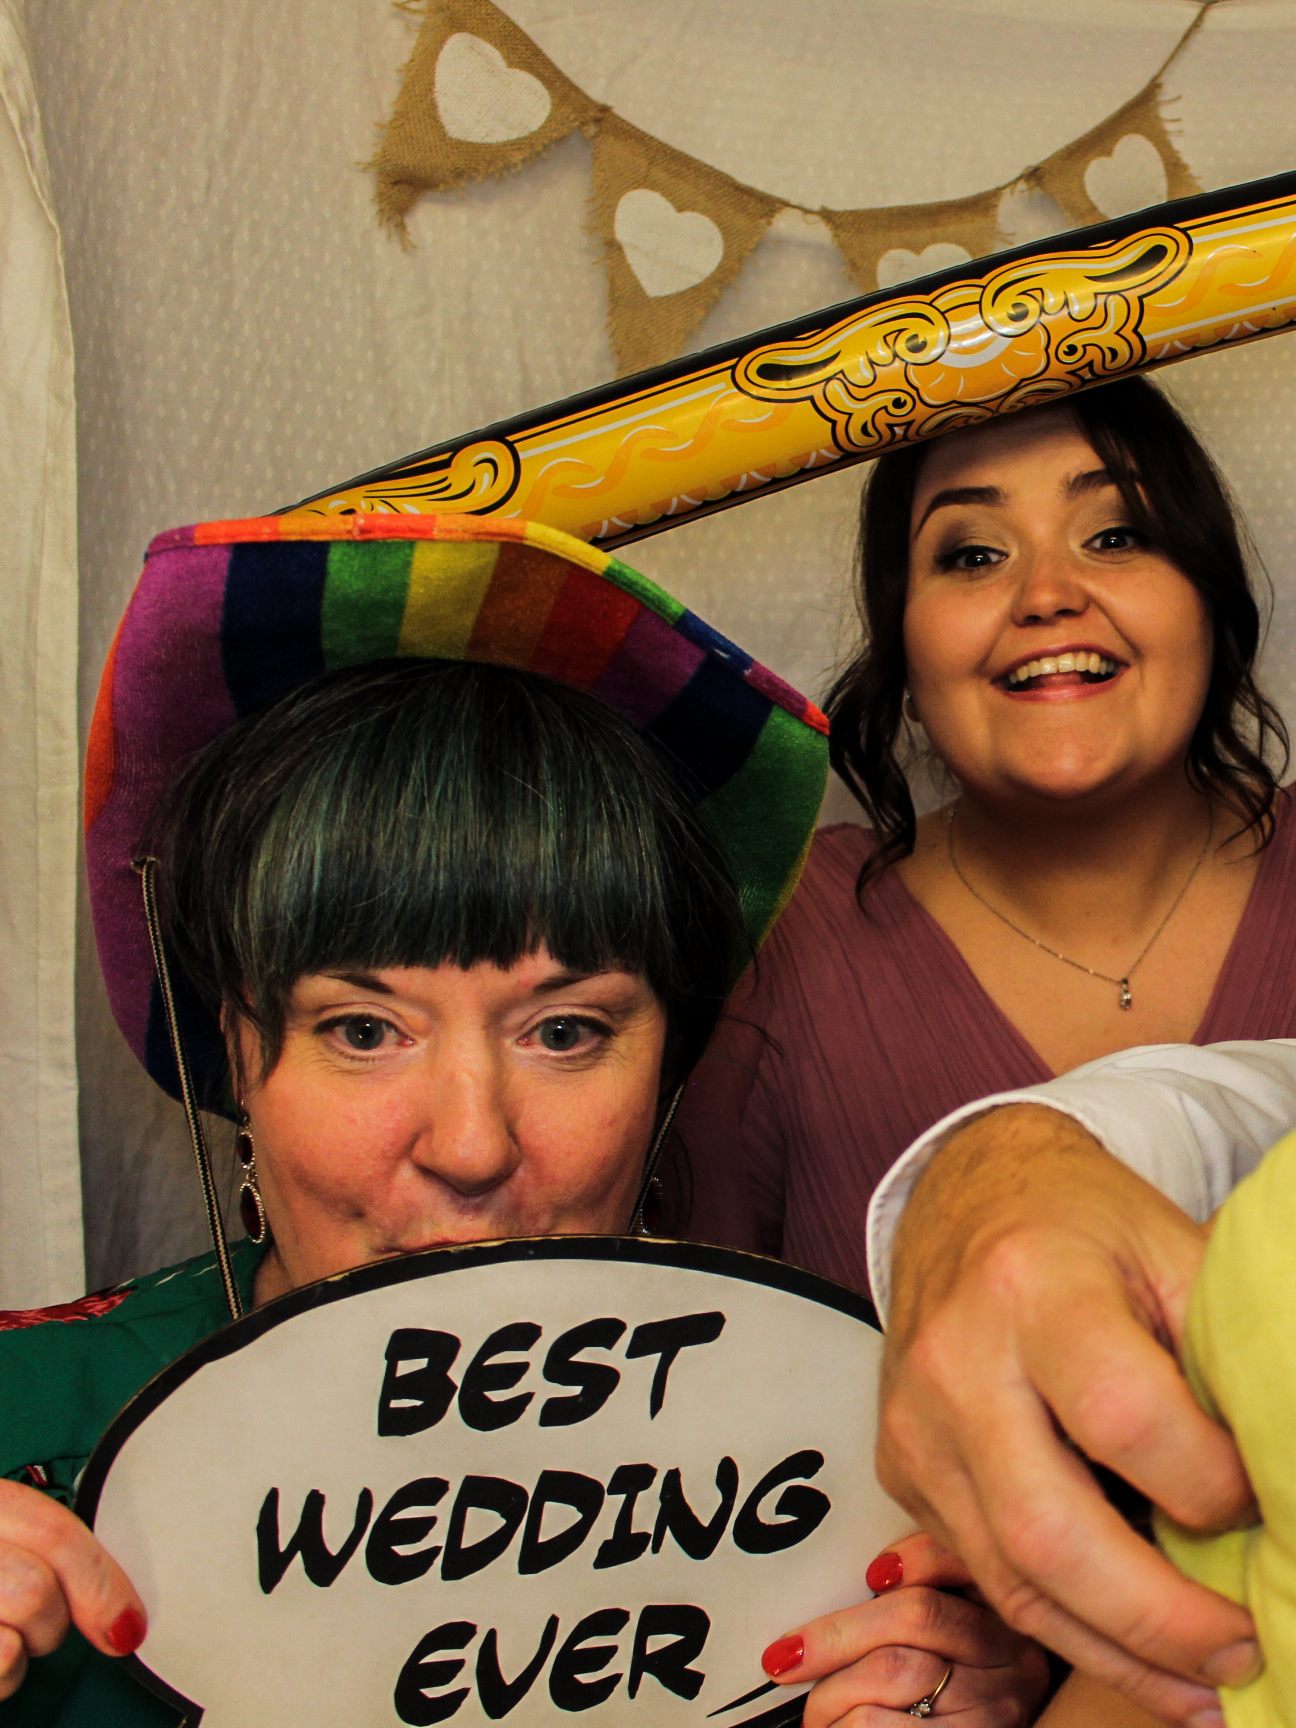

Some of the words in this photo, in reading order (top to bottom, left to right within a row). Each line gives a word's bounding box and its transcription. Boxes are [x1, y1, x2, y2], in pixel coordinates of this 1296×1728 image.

[377, 1310, 727, 1438] BEST
[255, 1449, 832, 1595] WEDDING
[393, 1604, 711, 1728] EVER
